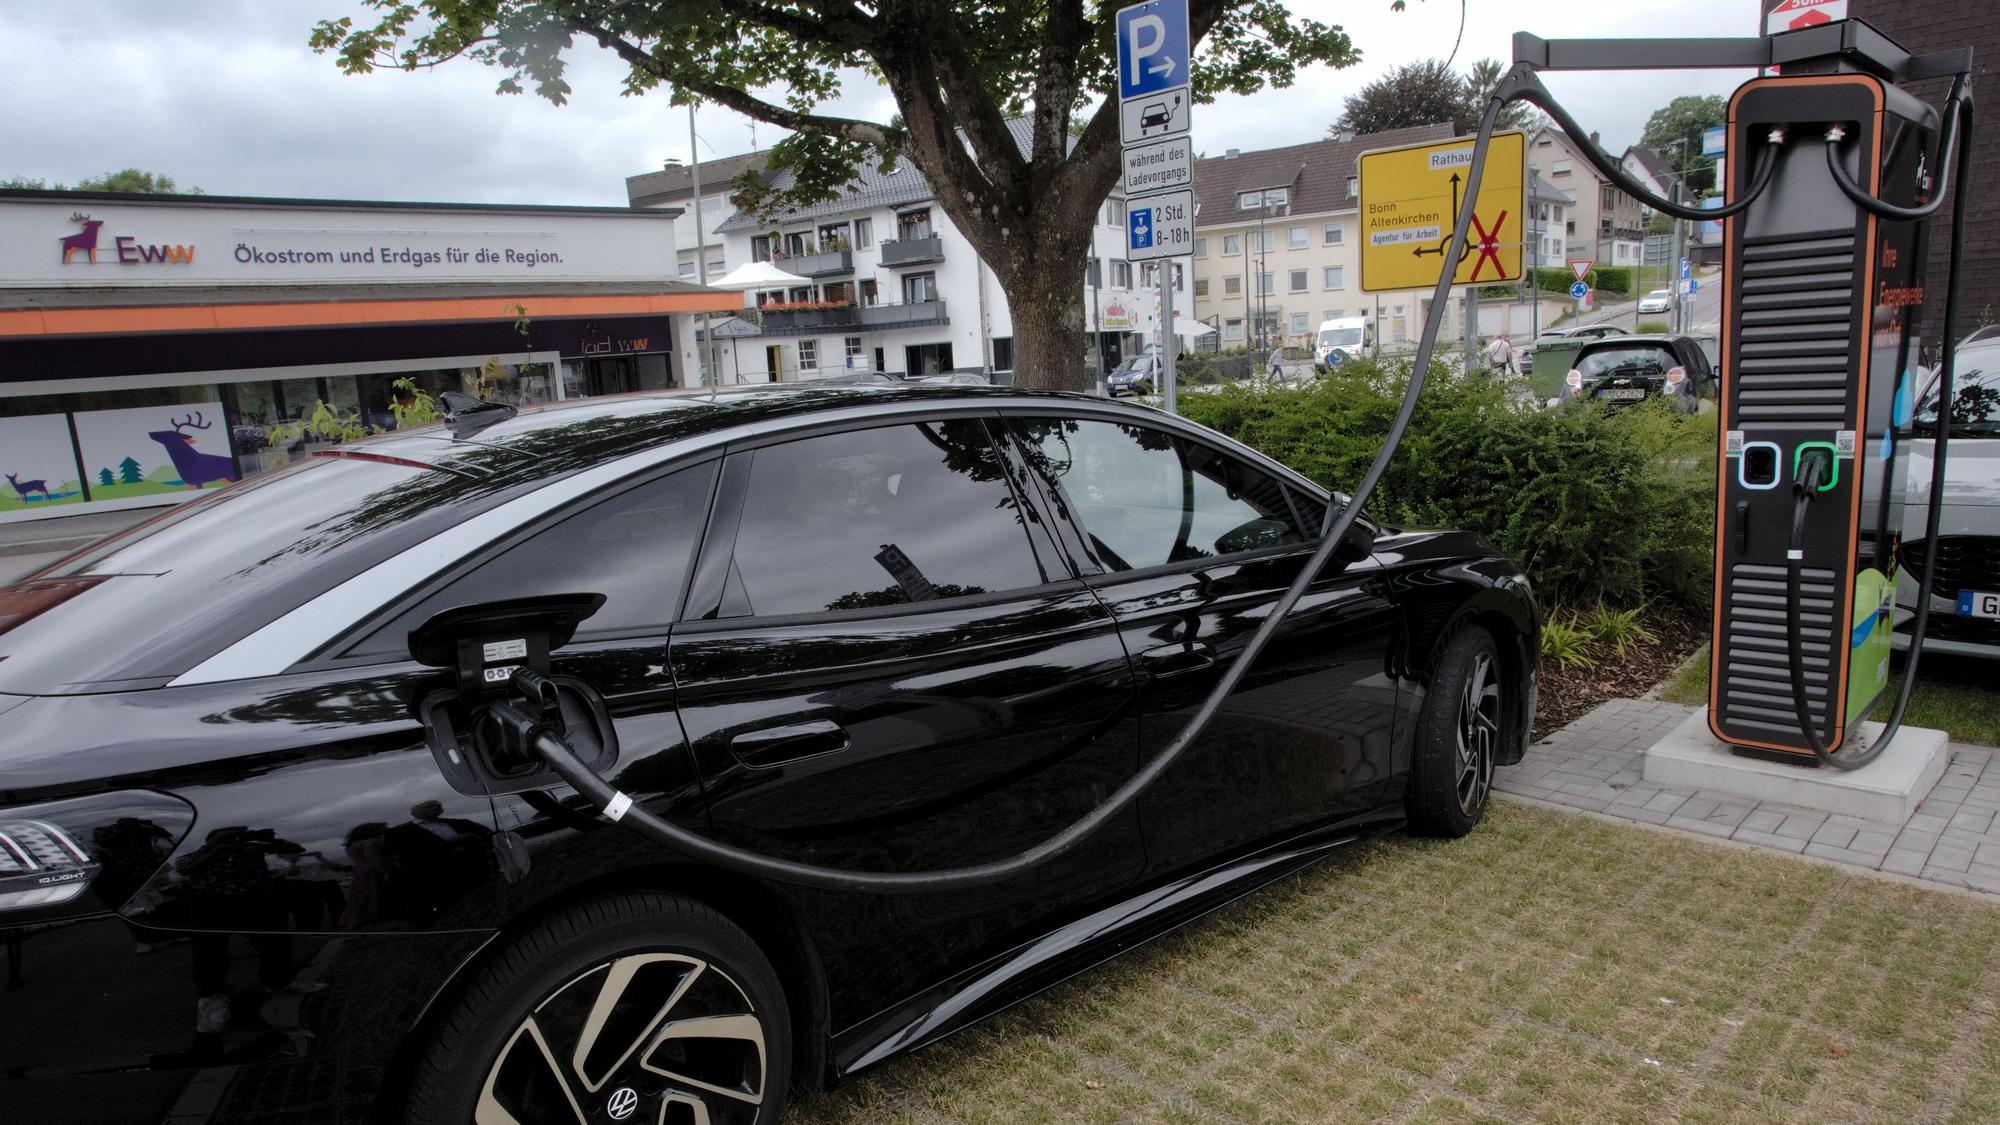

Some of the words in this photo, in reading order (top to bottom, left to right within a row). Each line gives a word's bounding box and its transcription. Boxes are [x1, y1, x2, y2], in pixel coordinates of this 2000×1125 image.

[1129, 14, 1165, 86] P
[1129, 150, 1165, 168] während
[1169, 147, 1185, 160] des
[1432, 153, 1472, 166] Rathau
[1128, 167, 1187, 187] Ladevorgangs
[1155, 207, 1162, 222] 2
[1165, 204, 1186, 221] Std.
[1369, 203, 1397, 214] Bonn
[1370, 212, 1440, 228] Altenkirchen
[1373, 233, 1400, 245] Agentur
[1402, 231, 1412, 241] für
[1416, 229, 1438, 239] Arbeit
[115, 236, 195, 265] Eww
[234, 243, 334, 264] Ökostrom
[340, 248, 374, 264] und
[381, 247, 441, 267] Erdgas
[447, 247, 469, 264] für
[475, 248, 500, 264] die
[505, 248, 564, 267] Region.
[1882, 239, 1897, 269] Ihre
[1982, 596, 2000, 615] G
[39, 871, 85, 884] IQ.LIGHT
